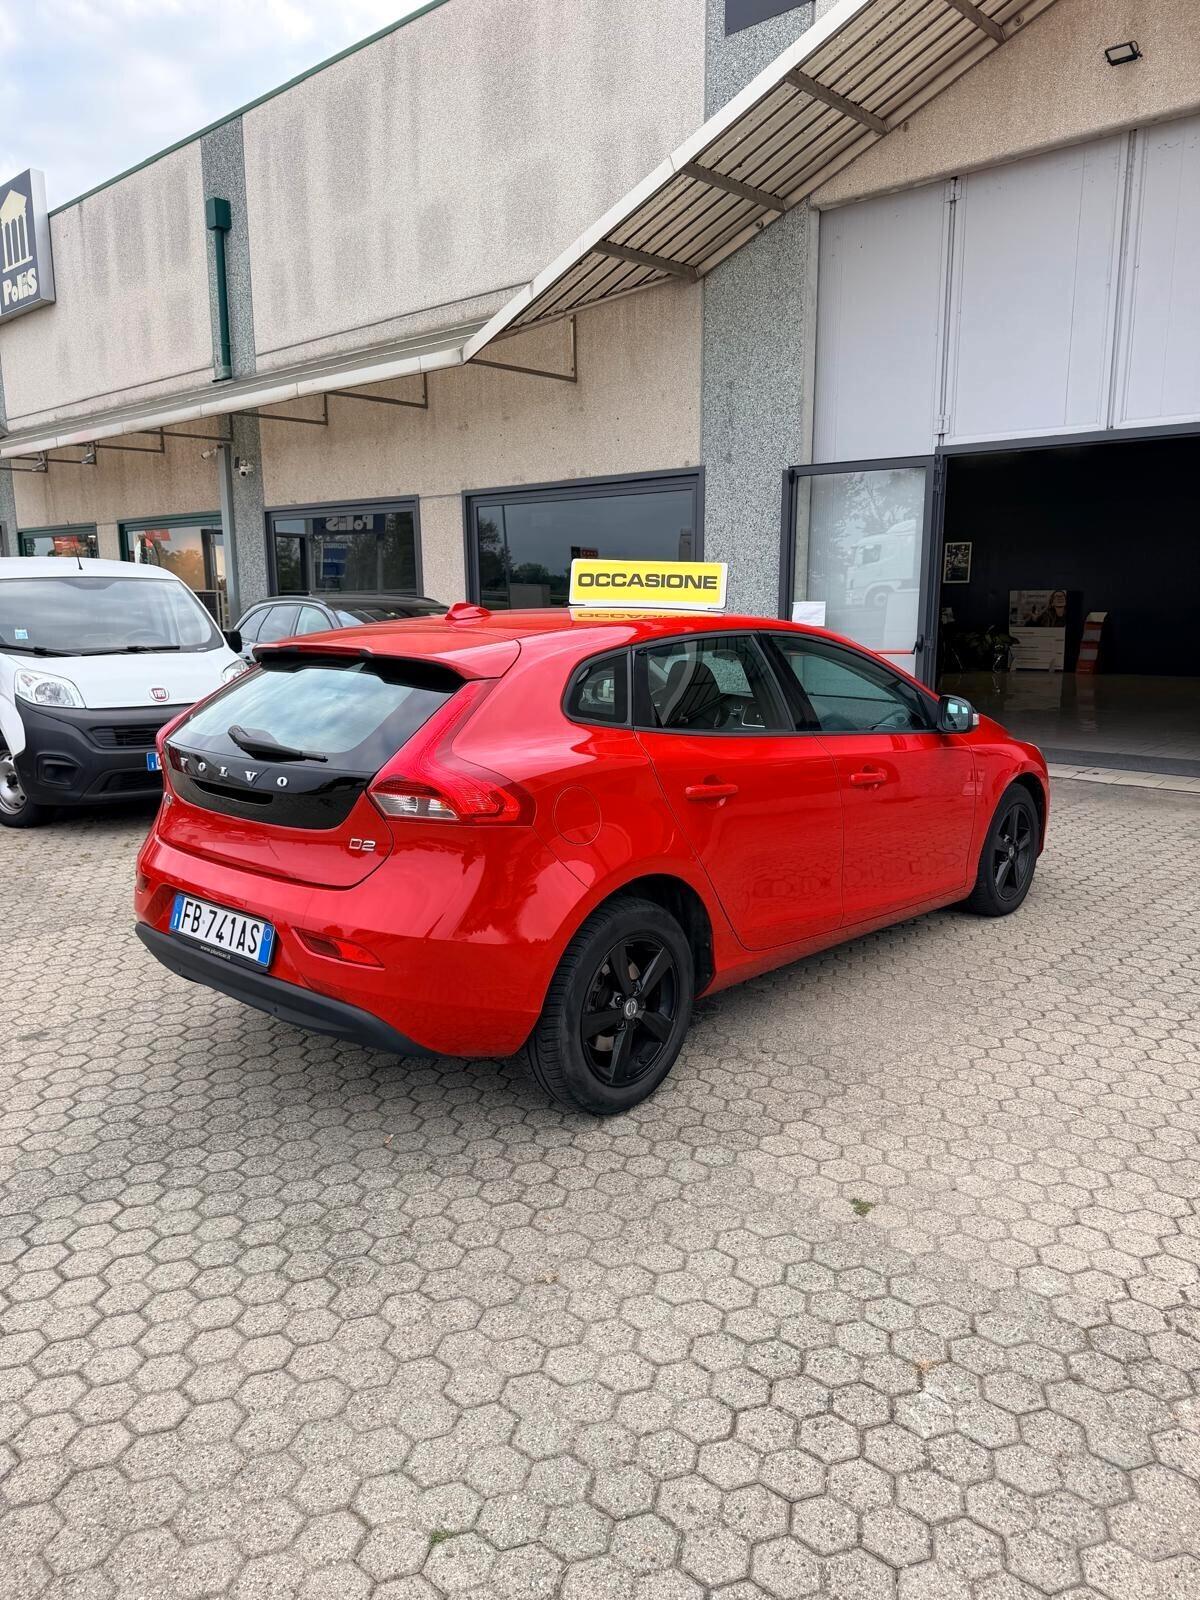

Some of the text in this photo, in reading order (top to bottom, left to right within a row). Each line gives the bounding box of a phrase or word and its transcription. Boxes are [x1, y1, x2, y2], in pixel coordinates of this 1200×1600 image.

[578, 573, 717, 589] OCCASIONE
[180, 757, 288, 787] VOLVO
[349, 838, 376, 851] D2
